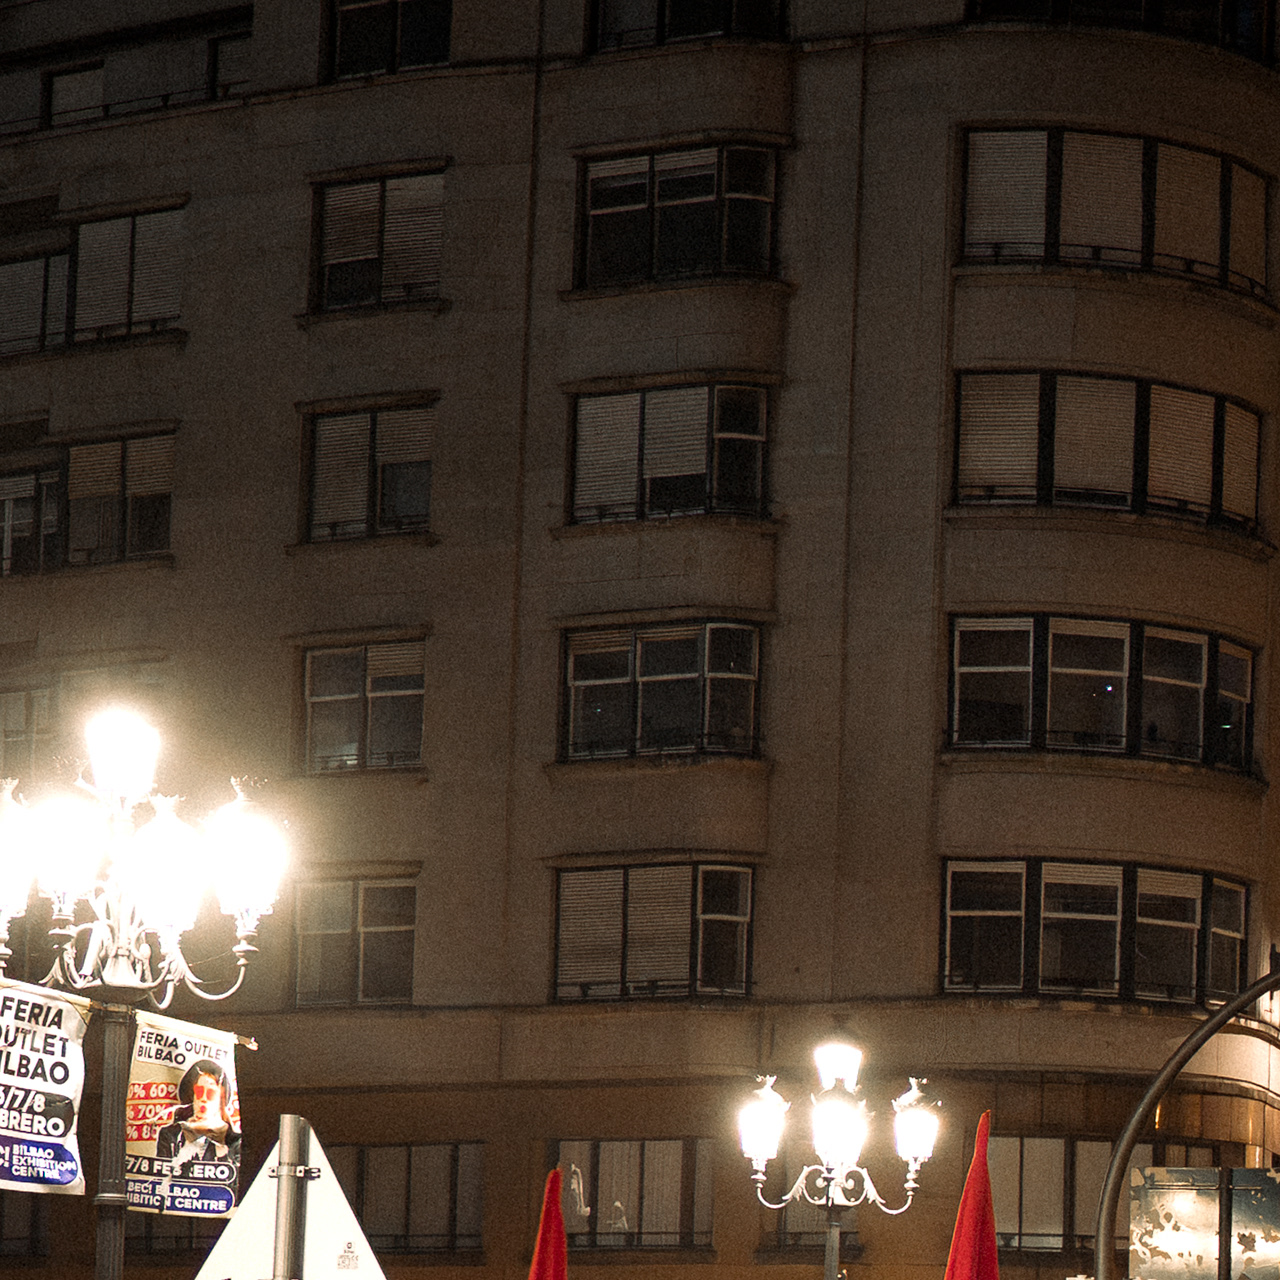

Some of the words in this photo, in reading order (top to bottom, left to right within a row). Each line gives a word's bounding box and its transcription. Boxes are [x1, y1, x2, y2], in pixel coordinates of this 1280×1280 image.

[0, 996, 63, 1029] FERIA
[0, 1025, 69, 1057] UTLET
[140, 1031, 179, 1050] FERIA
[184, 1040, 229, 1060] OUTLET
[137, 1045, 186, 1065] BILBAO
[12, 1144, 54, 1160] BILBAO
[12, 1155, 77, 1171] EXHIBITION
[174, 1197, 228, 1211] CENTRE
